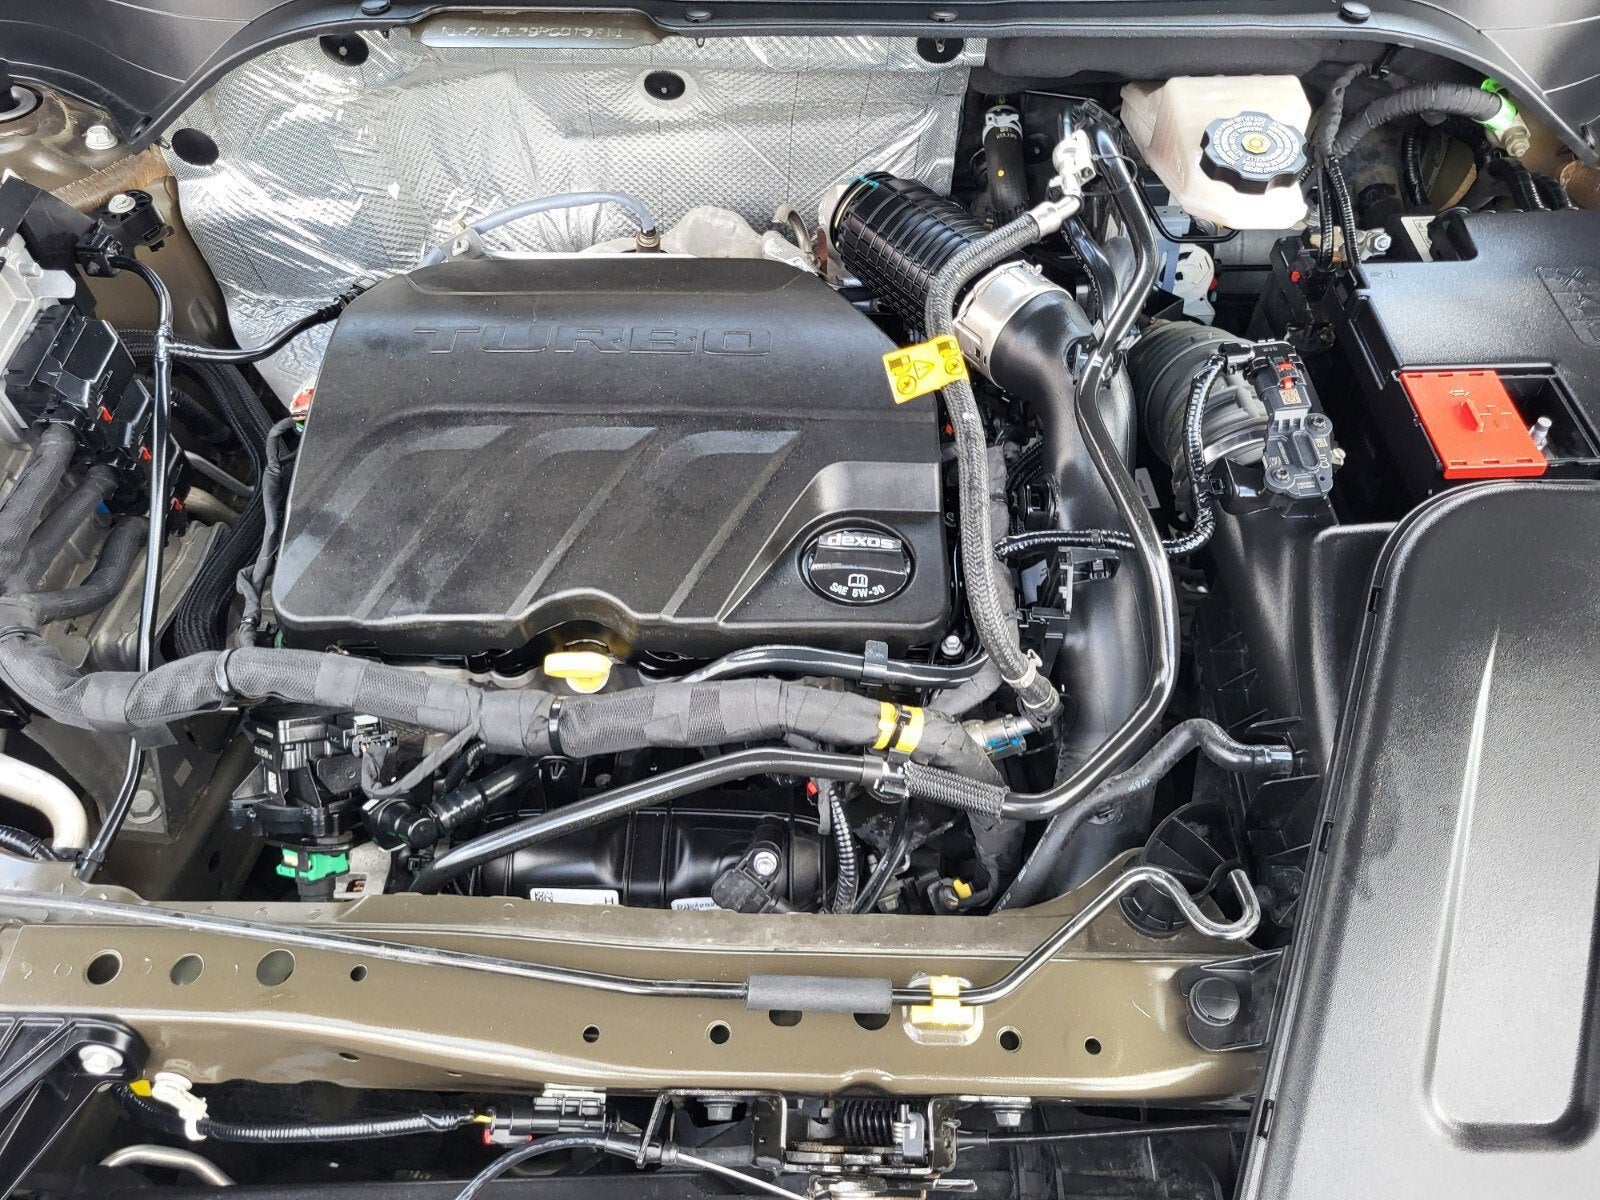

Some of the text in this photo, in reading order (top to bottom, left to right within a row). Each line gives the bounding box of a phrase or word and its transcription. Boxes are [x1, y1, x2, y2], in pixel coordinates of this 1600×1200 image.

[412, 325, 773, 356] TURBO
[827, 532, 894, 549] dexos
[829, 583, 885, 597] SAE 5W-30
